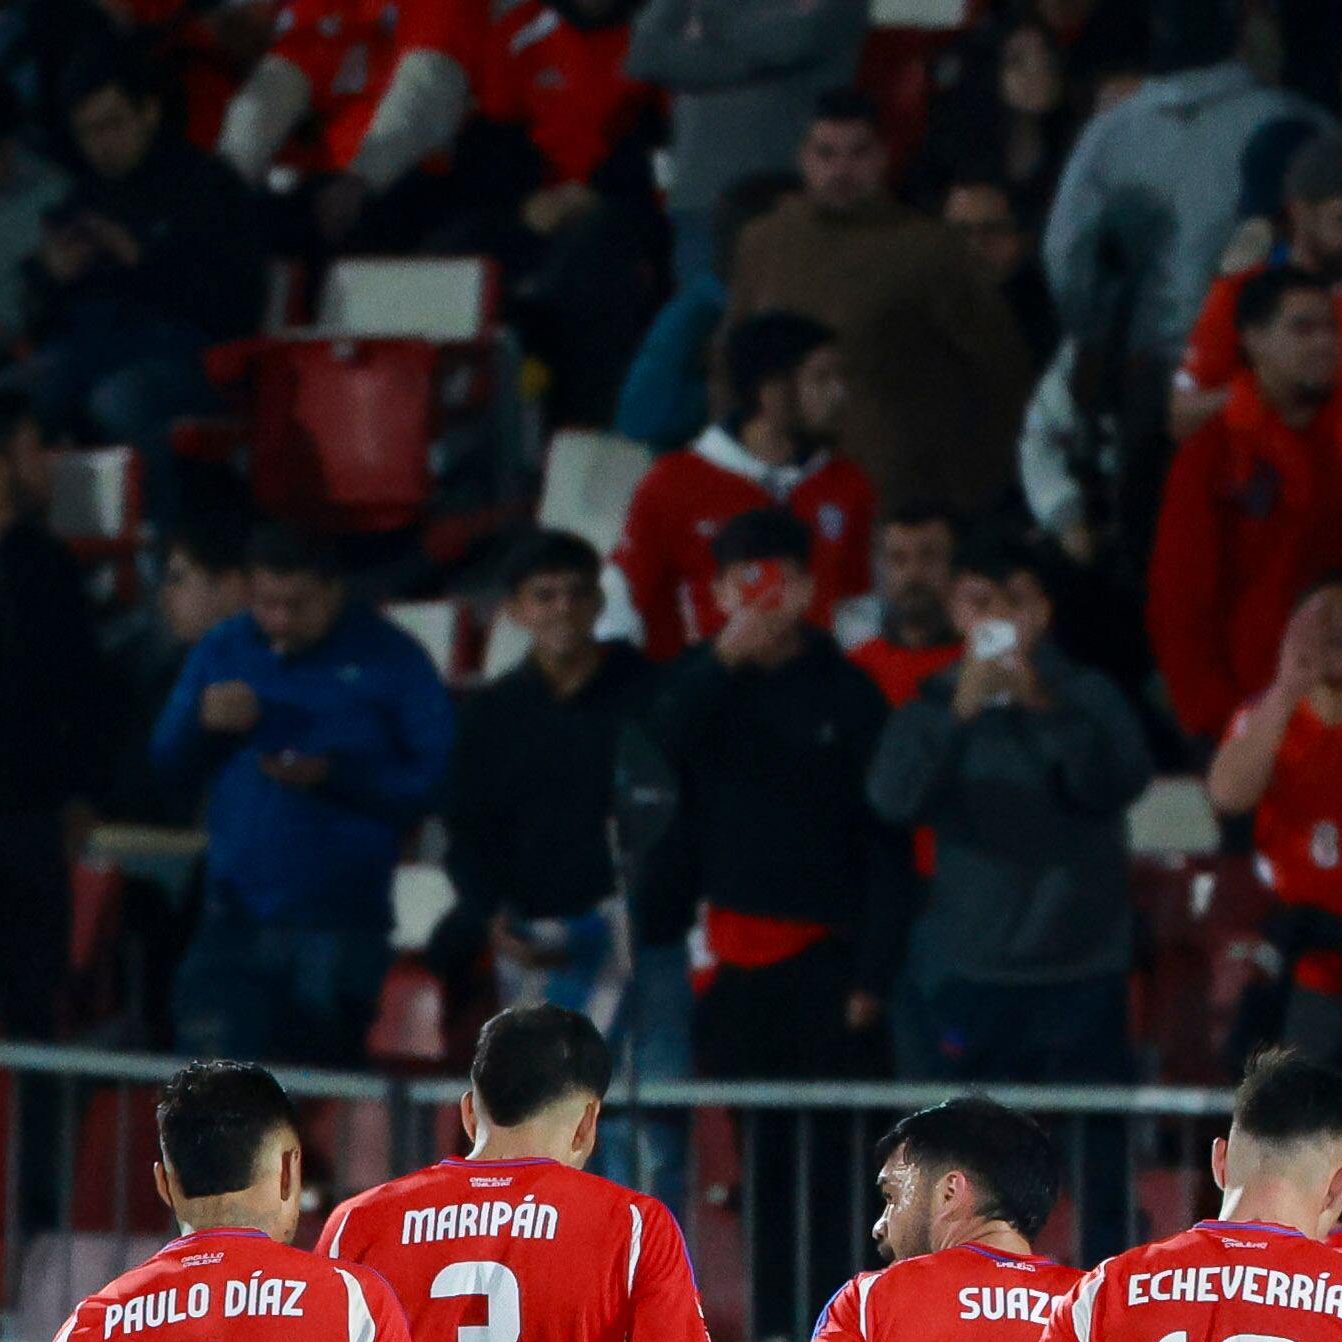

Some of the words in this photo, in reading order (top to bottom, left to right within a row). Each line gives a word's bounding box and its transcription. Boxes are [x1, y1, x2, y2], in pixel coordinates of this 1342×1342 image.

[402, 1195, 557, 1244] MARIPÁN
[105, 1283, 209, 1340] PAULO
[225, 1271, 306, 1317] DÍAZ
[959, 1287, 1067, 1326] SUAZ
